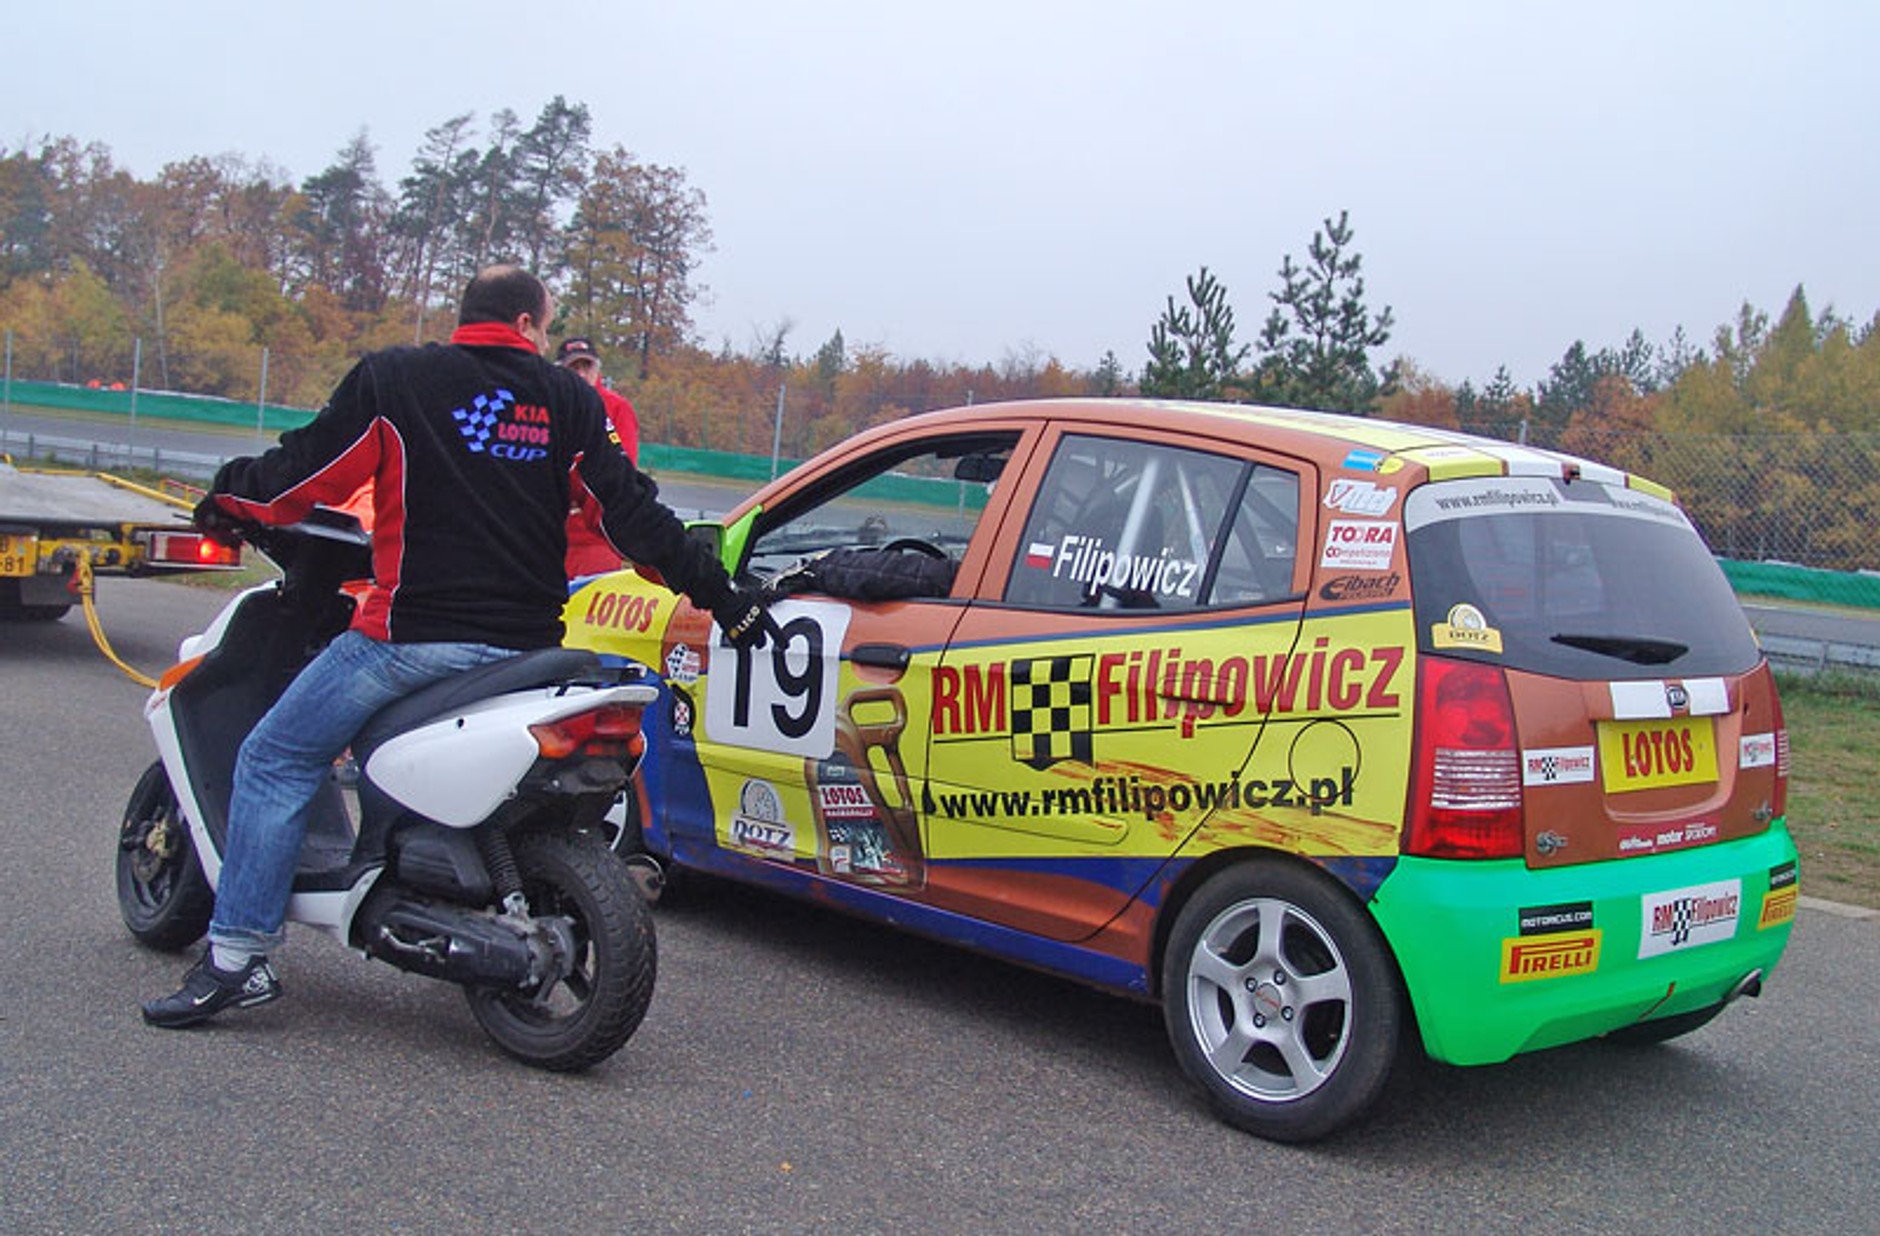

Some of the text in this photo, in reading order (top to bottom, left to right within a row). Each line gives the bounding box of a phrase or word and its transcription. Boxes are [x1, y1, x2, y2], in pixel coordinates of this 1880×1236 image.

[498, 423, 549, 444] LOTOS
[514, 404, 549, 422] KIA
[489, 443, 547, 461] CUP
[1053, 535, 1198, 597] Filipowicz
[585, 591, 659, 633] LOTOS
[720, 616, 823, 739] 19
[932, 637, 1404, 738] RM Filipowicz
[1623, 729, 1694, 778] LOTOS
[820, 787, 866, 805] LOTOS
[939, 767, 1354, 823] www.rmfilipowicz.pl
[733, 820, 792, 843] DOTZ
[1652, 891, 1738, 932] RM Filipowicz
[1509, 938, 1594, 974] PIRELLI
